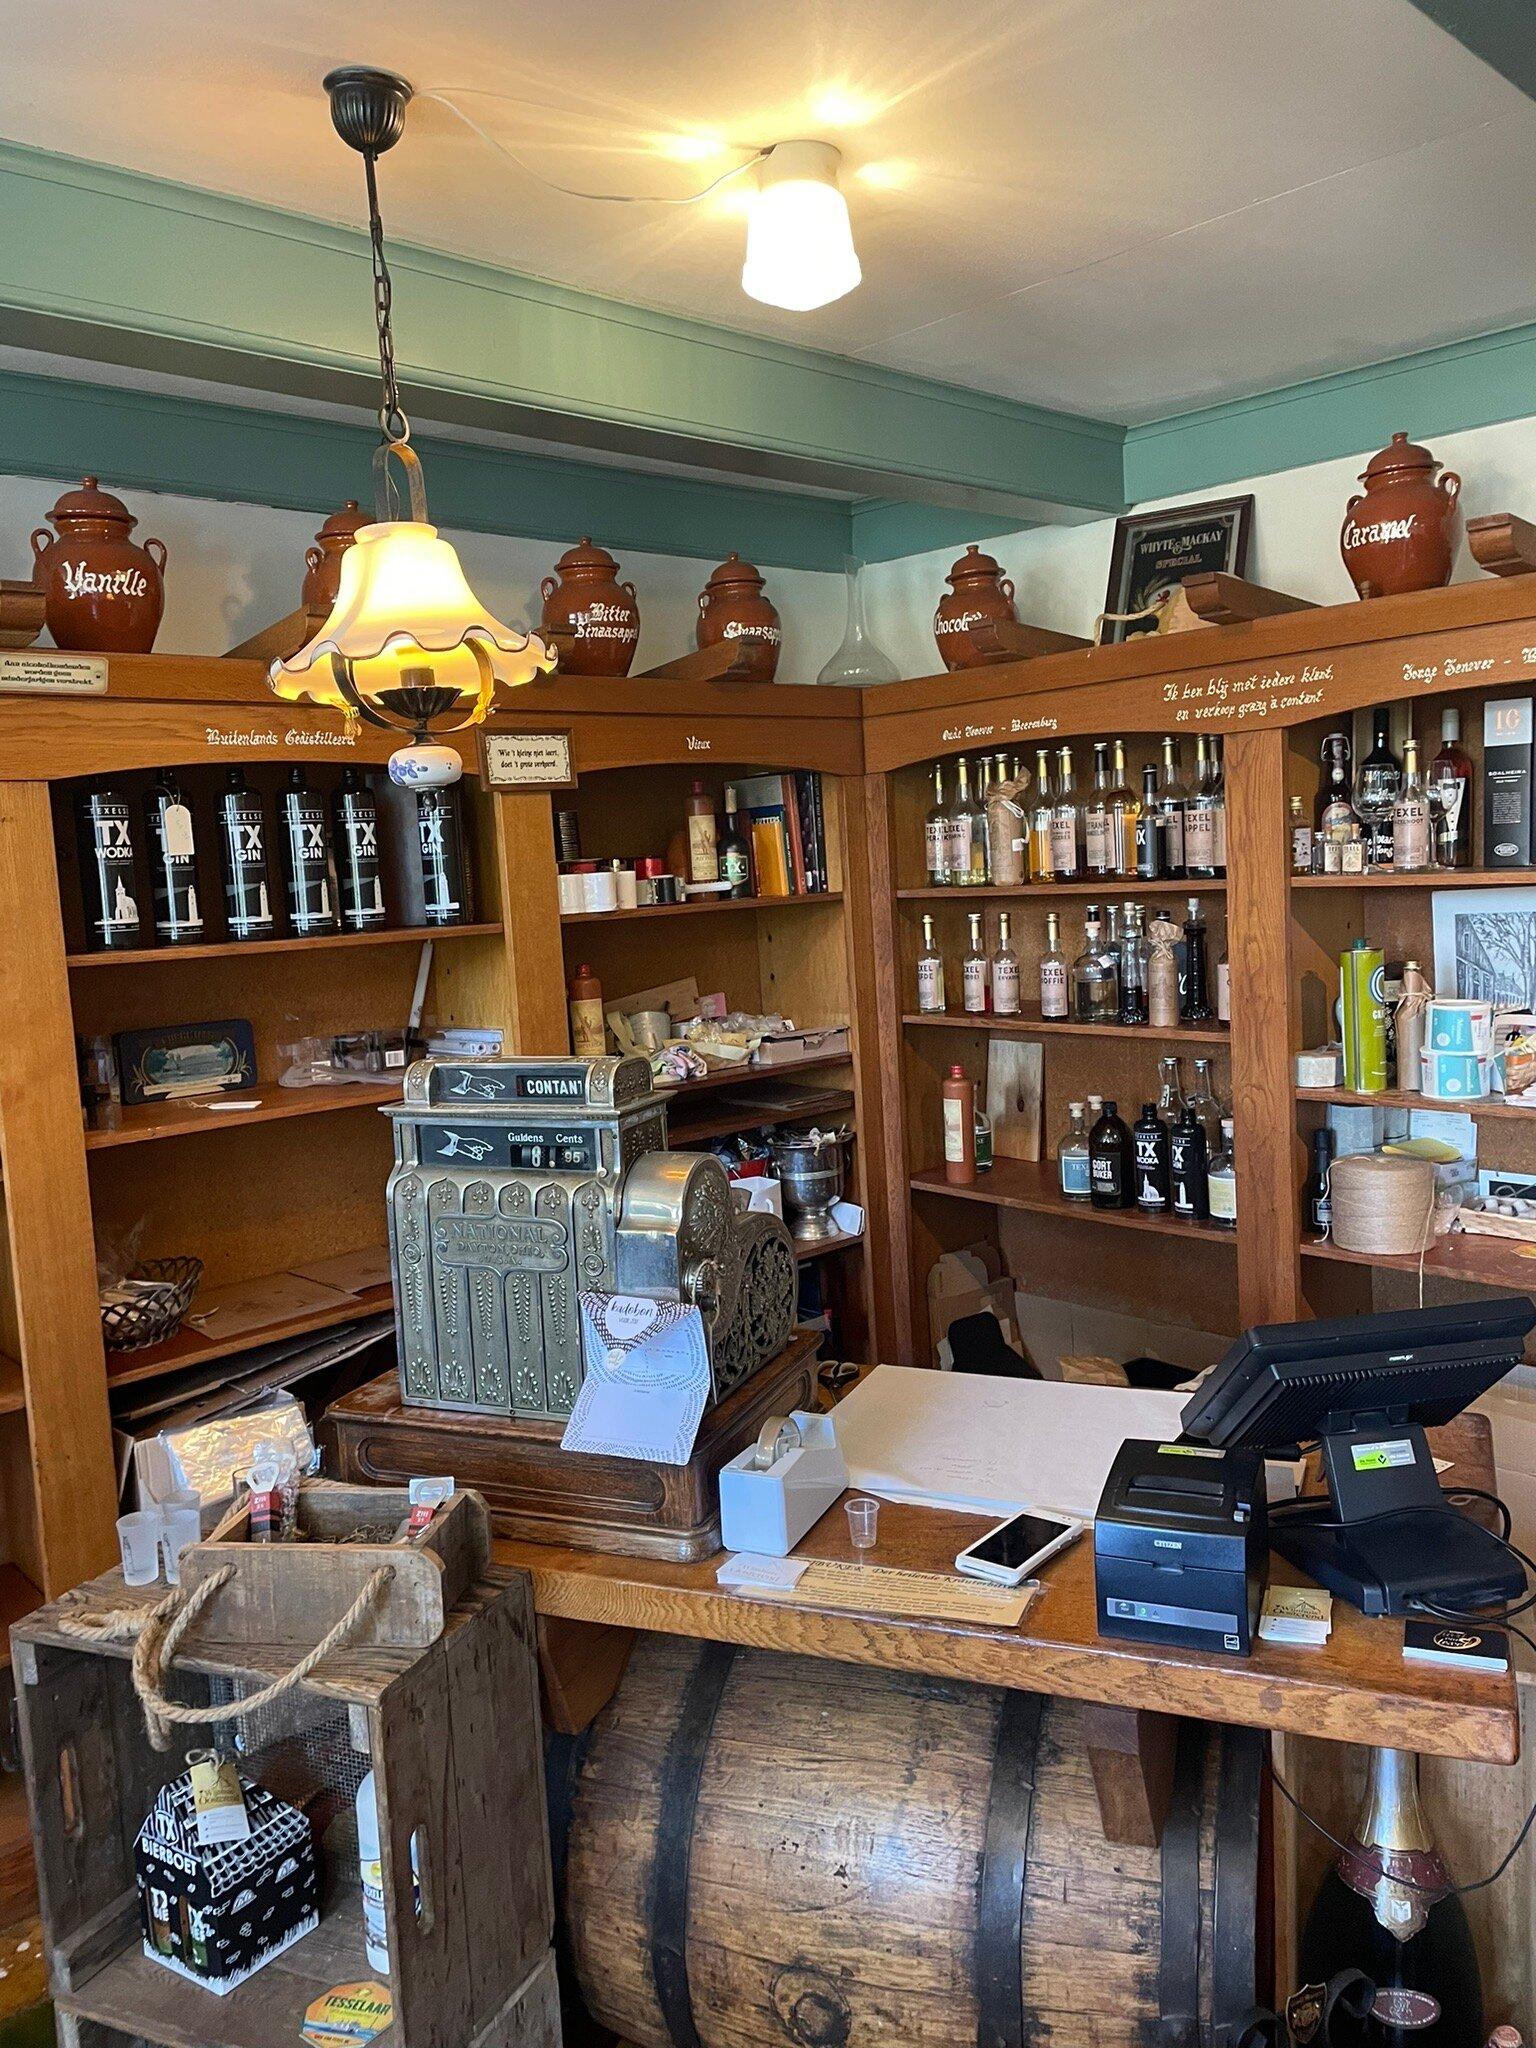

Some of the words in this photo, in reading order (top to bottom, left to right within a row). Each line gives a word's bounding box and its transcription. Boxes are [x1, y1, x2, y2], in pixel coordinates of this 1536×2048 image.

[1140, 538, 1175, 554] WHYTE
[1181, 530, 1223, 547] MACKAY
[1343, 515, 1416, 550] Caramel
[61, 560, 147, 597] Vanille
[589, 602, 631, 622] Bitter
[1163, 683, 1179, 702] Ik
[1182, 683, 1203, 699] ben
[1207, 678, 1229, 700] blij
[1233, 675, 1258, 693] met
[1260, 671, 1296, 691] iedere
[1175, 709, 1190, 722] en
[1195, 701, 1236, 720] verkoop
[1238, 701, 1268, 719] graag
[205, 727, 278, 746] Buitenlands
[95, 820, 131, 846] TX
[229, 825, 263, 850] TX
[291, 824, 323, 848] TX
[345, 823, 377, 846] TX
[418, 820, 444, 843] TX
[235, 849, 261, 861] GIN
[299, 848, 323, 859] GIN
[353, 846, 376, 857] GIN
[421, 843, 443, 854] GIN
[508, 1132, 544, 1144] Guldens
[555, 1132, 583, 1144] Cents
[1137, 1142, 1158, 1158] TX
[451, 1222, 549, 1244] NATIONAL
[1153, 1539, 1182, 1550] CITIZEN
[142, 1837, 197, 1877] BIERBOET
